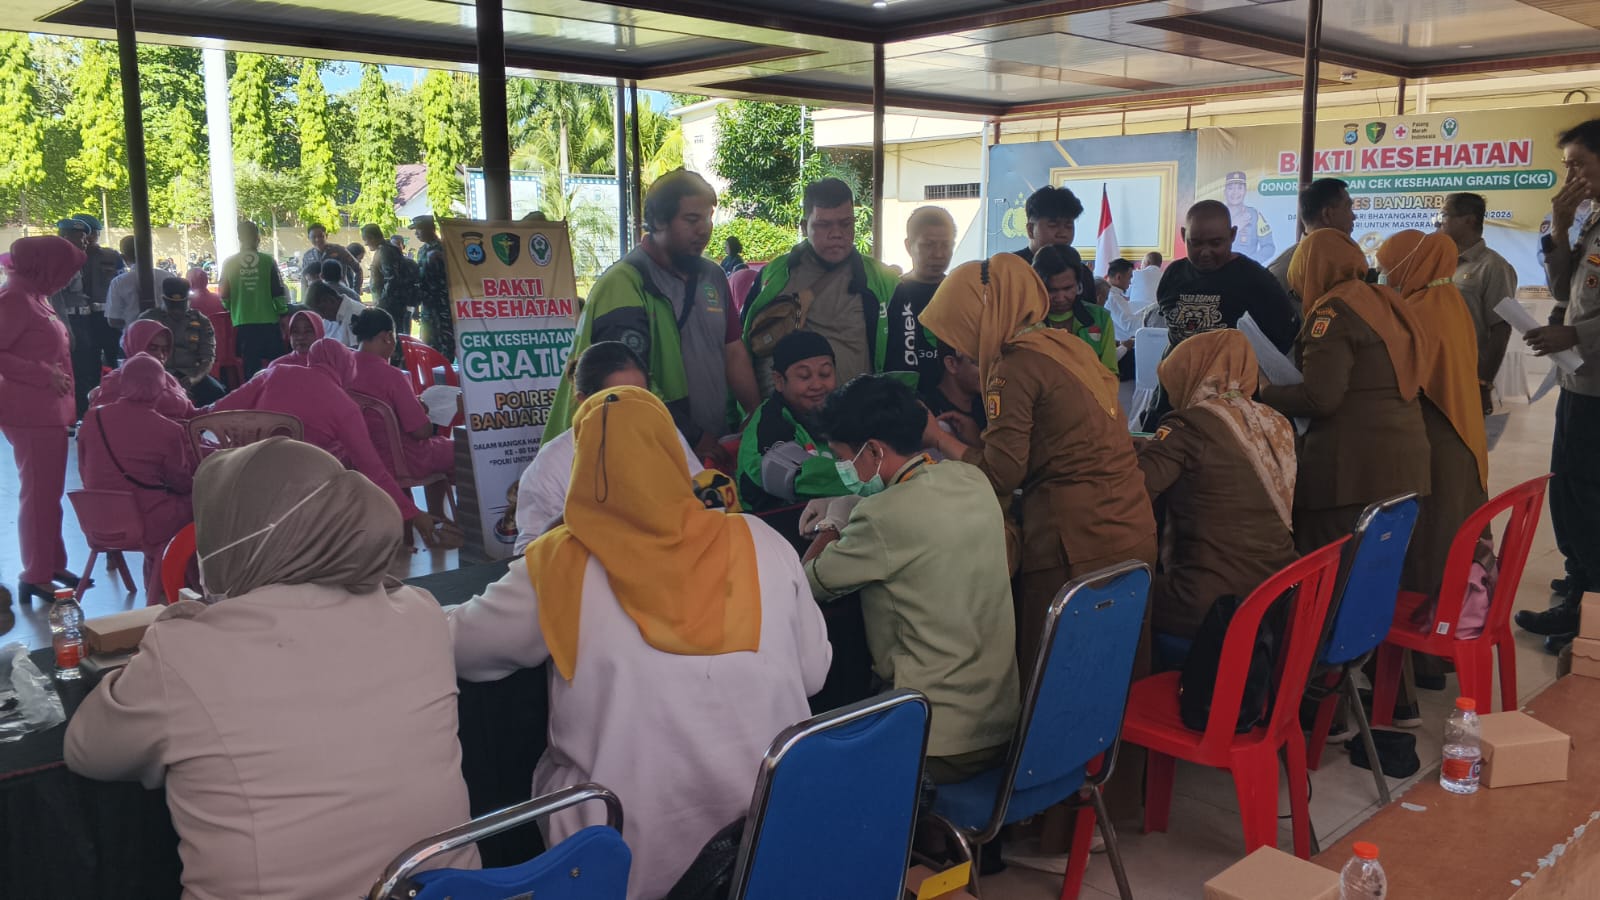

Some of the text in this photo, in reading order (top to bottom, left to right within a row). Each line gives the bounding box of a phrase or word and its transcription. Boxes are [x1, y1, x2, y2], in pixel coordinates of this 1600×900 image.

[1280, 140, 1530, 173] BKTI KESEHATAN
[1368, 178, 1391, 189] CEK
[1394, 176, 1463, 188] KESEHATAN
[1466, 174, 1511, 186] GRATIS
[1514, 172, 1553, 187] (CKG)
[1373, 194, 1446, 210] BANJARB
[1368, 212, 1428, 220] BHAYANGKARA
[1364, 221, 1390, 229] UNTUK
[483, 278, 544, 297] BAKTI
[456, 298, 573, 318] KESEHATAN
[462, 331, 574, 348] CEK KESEHATAN
[474, 442, 497, 450] DALAM
